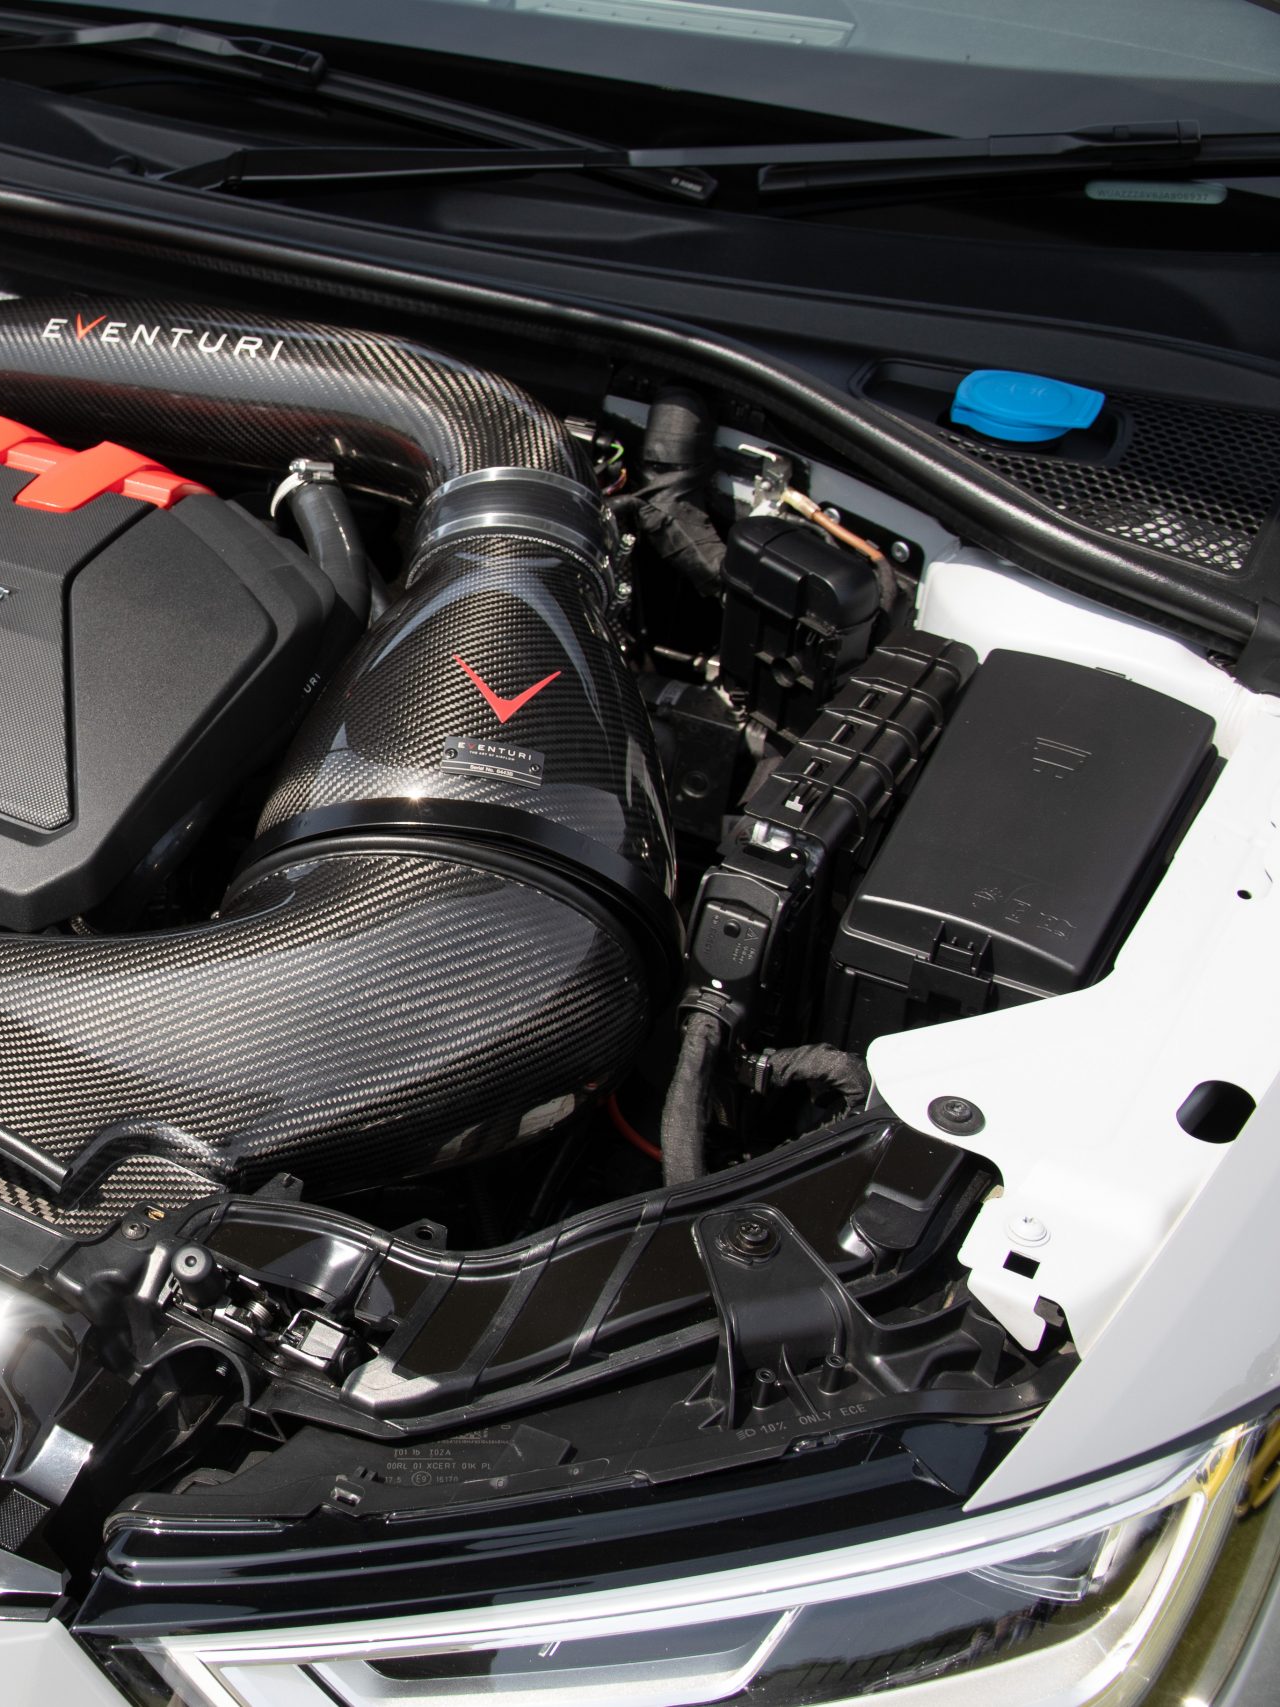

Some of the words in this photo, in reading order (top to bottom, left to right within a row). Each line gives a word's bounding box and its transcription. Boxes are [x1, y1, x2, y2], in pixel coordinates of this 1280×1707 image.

[42, 312, 284, 361] EVENTURI
[457, 741, 532, 761] EVENTURI
[760, 1420, 787, 1434] 10%
[798, 1410, 832, 1425] ONLY
[839, 1403, 867, 1417] ECE
